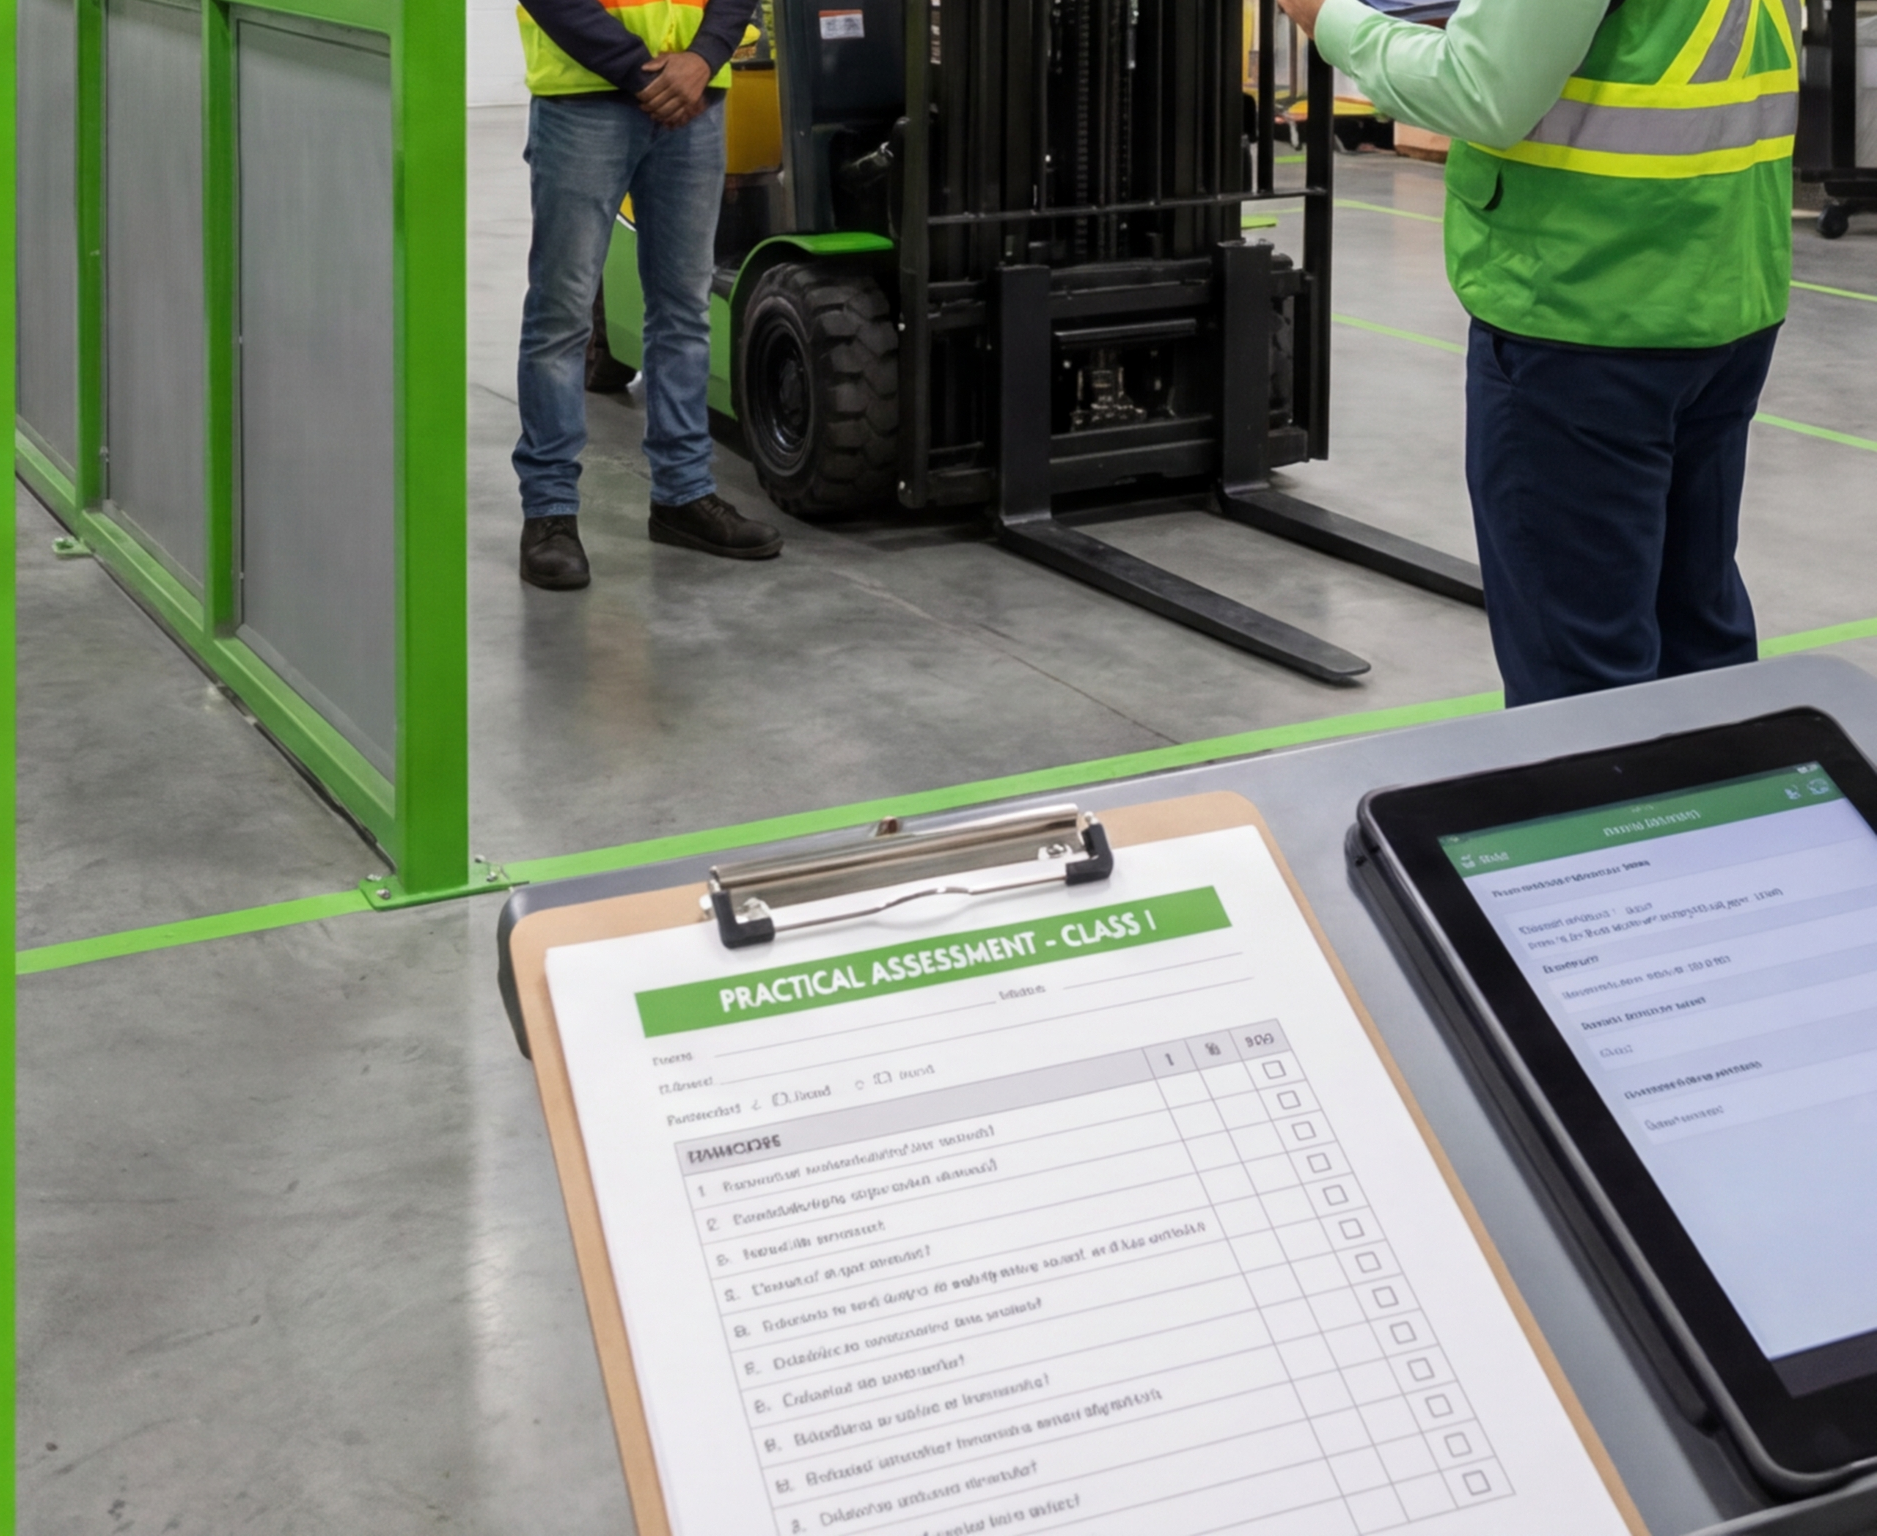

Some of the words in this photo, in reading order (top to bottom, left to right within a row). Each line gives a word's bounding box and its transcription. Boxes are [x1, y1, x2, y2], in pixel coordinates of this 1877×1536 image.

[719, 966, 865, 1013] PRACTICAL
[872, 931, 1037, 986] ASSESSMENT
[1061, 912, 1141, 947] CLASS
[1144, 909, 1157, 930] I
